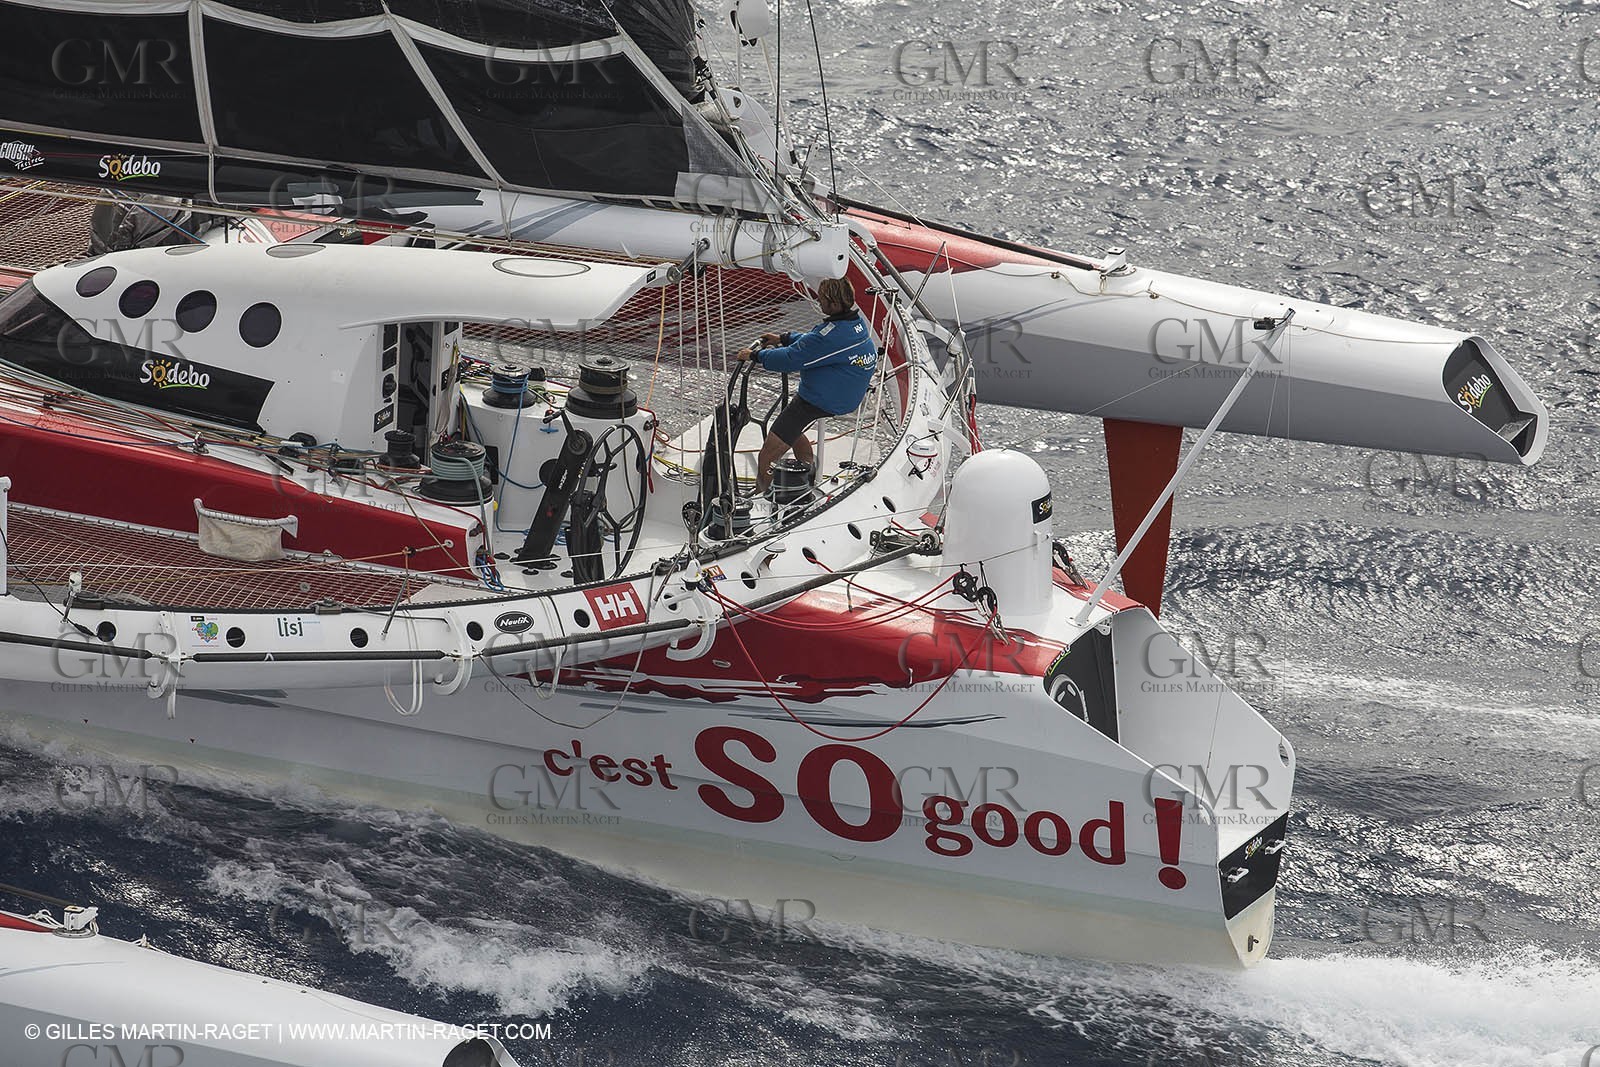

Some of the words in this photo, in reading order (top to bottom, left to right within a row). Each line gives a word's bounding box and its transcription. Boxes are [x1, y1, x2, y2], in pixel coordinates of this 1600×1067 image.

[98, 154, 161, 179] Sodebo
[140, 360, 210, 387] Sodebo
[1457, 374, 1492, 413] Sodebo
[594, 591, 638, 621] HH
[276, 617, 304, 637] lisi
[543, 739, 680, 791] c'est
[694, 725, 904, 843] SO
[922, 795, 1127, 866] good
